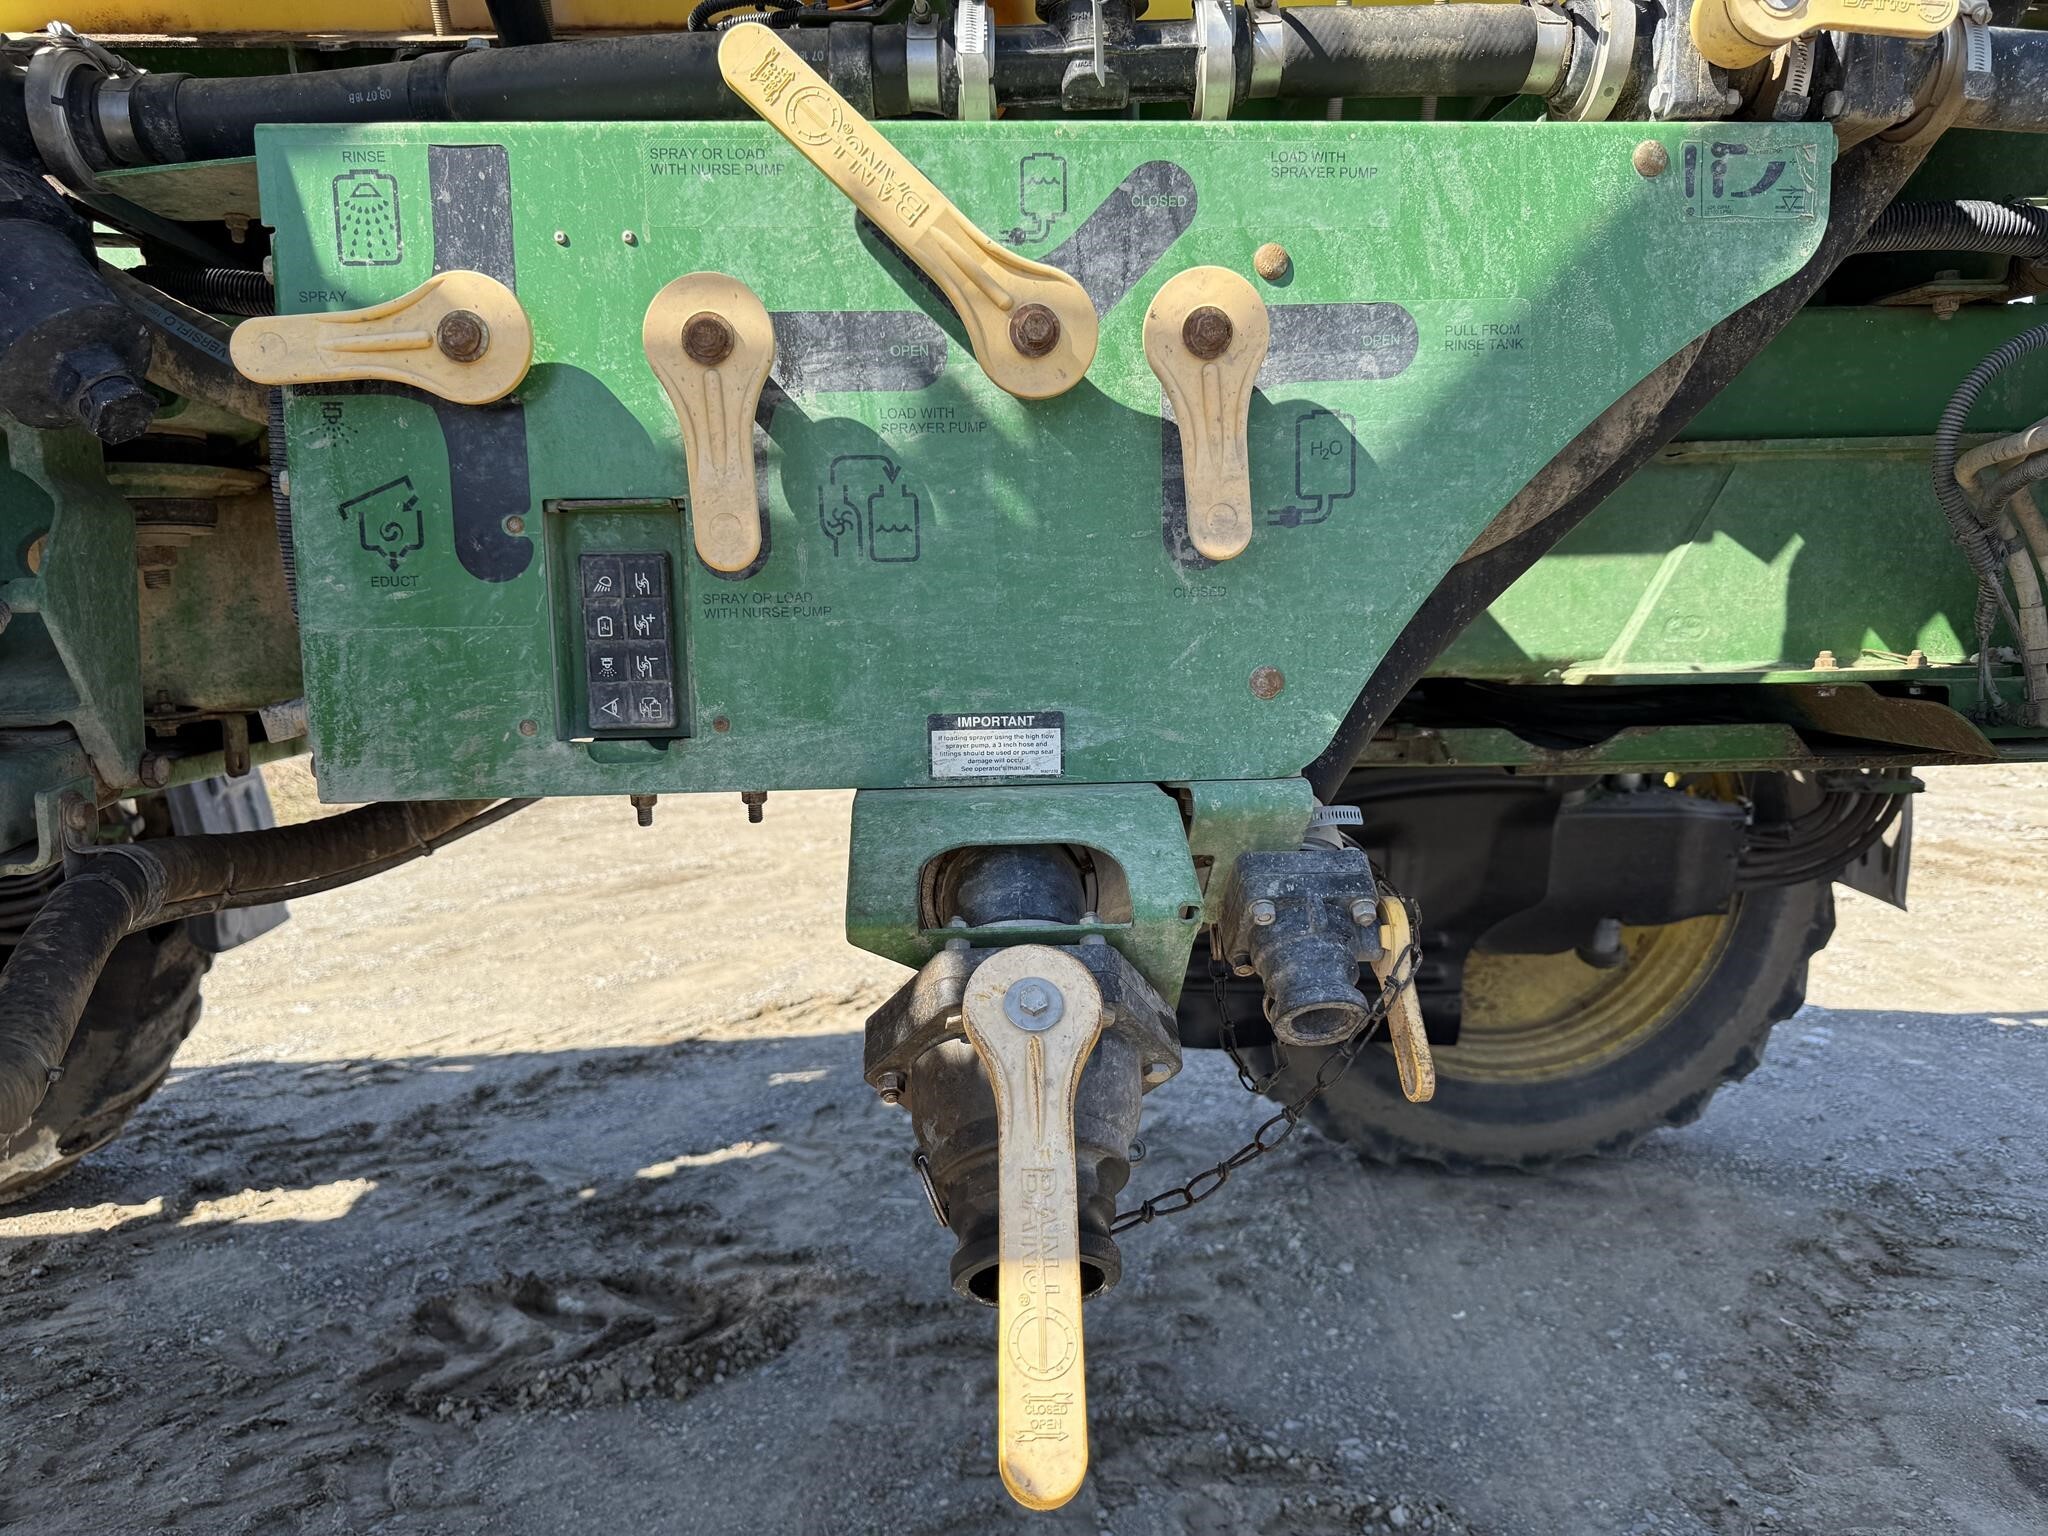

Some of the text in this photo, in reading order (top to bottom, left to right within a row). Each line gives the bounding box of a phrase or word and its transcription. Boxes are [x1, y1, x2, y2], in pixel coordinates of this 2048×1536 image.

[380, 89, 391, 101] 08
[342, 150, 387, 164] RINSE
[650, 148, 766, 161] SPRAY OR LOAD
[1271, 151, 1347, 164] LOAD WITH
[650, 163, 785, 176] WITH NURSE PUMP
[1271, 166, 1378, 179] SPRAYER PUMP
[1131, 195, 1187, 208] CLOSED
[299, 291, 347, 304] SPRAY
[1445, 323, 1521, 337] PULL FROM
[1362, 335, 1400, 347] OPEN
[1444, 337, 1524, 351] RINSE TANK
[890, 345, 929, 357] OPEN
[879, 407, 955, 420] LOAD WITH
[881, 421, 988, 434] SPRAYER PUMP
[370, 575, 420, 588] EDUCT
[703, 592, 813, 606] SPRAY OR LOAD
[1173, 586, 1227, 599] CLOSED
[703, 605, 832, 619] WITH NURSE PUMP
[957, 715, 1035, 727] IMPORTANT
[1025, 733, 1040, 741] high
[1025, 1404, 1068, 1415] CLOSED
[1030, 1418, 1062, 1430] OPEN
